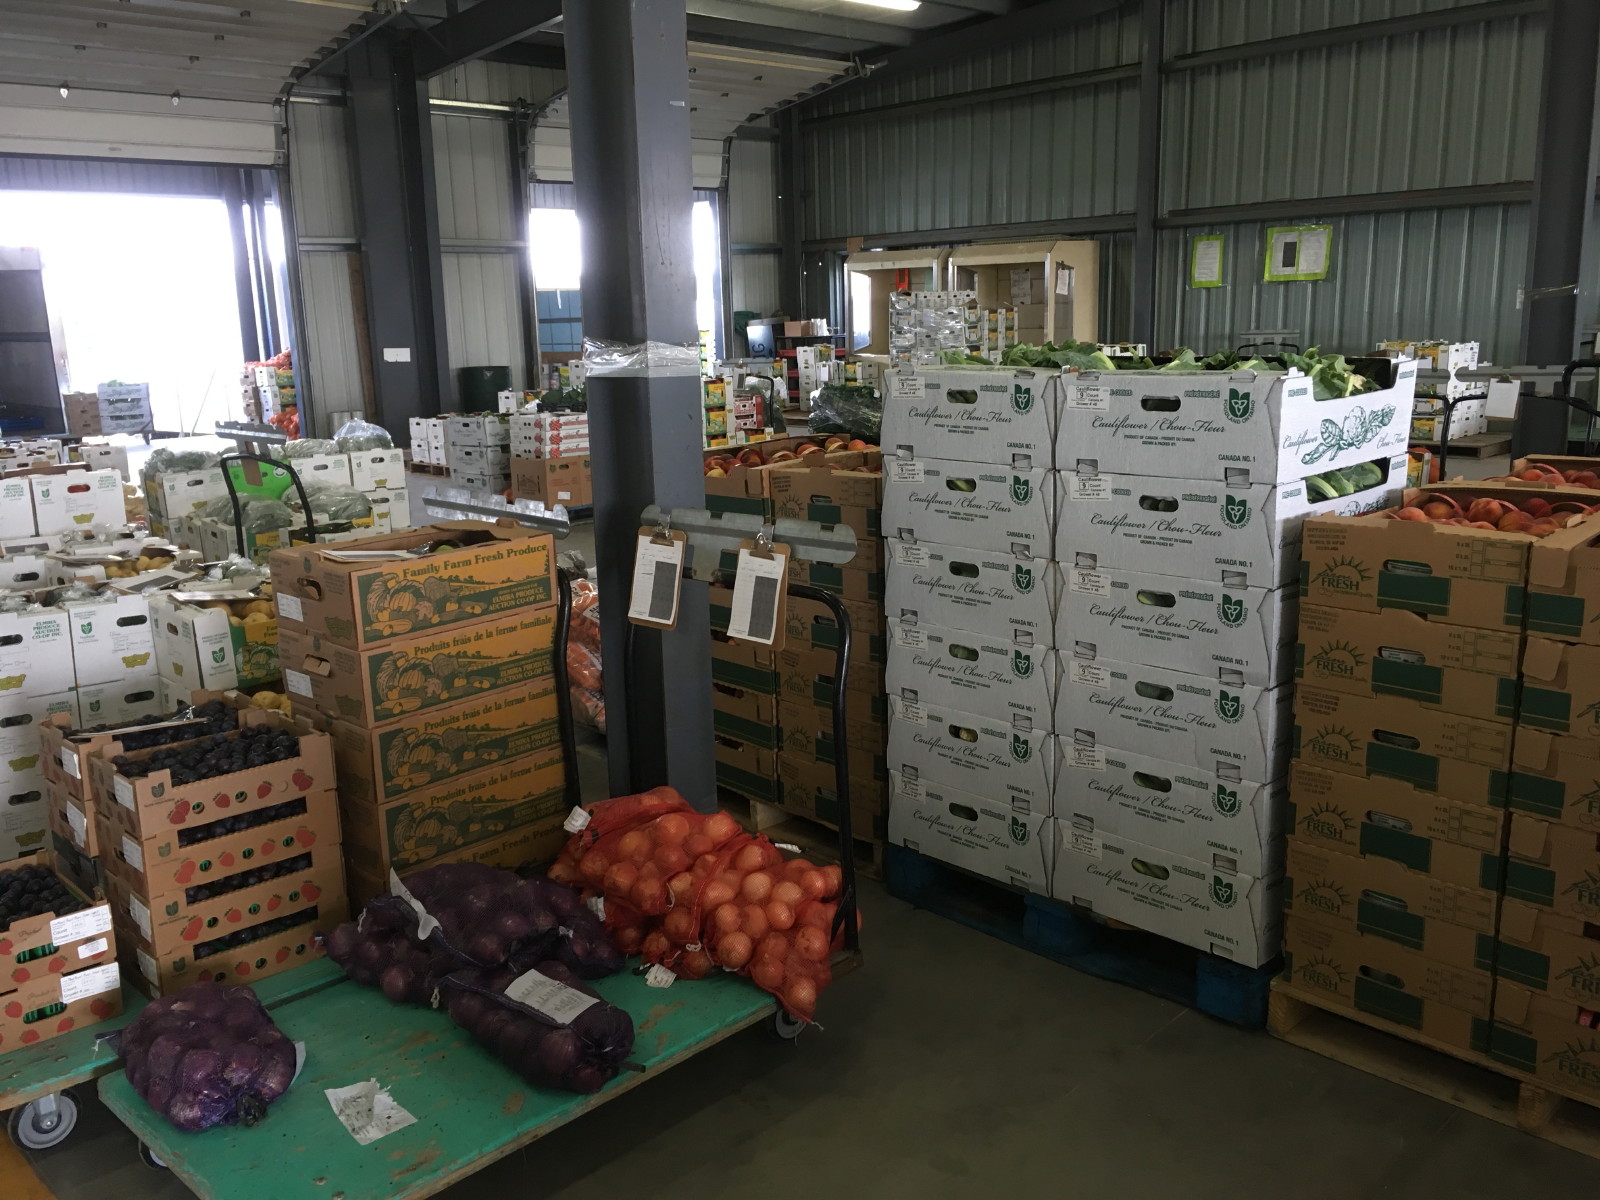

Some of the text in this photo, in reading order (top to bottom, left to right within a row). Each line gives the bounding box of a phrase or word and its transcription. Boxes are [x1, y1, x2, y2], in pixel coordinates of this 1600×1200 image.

[908, 405, 953, 426] Cauliflower
[1092, 414, 1148, 438] Cauliflower
[1282, 429, 1318, 455] Cauliflower
[909, 491, 953, 511] Cauliflower
[1090, 512, 1146, 535] Cauliflower
[403, 544, 546, 578] Family Farm Fresh Produce
[1215, 557, 1238, 566] CANADA
[913, 574, 956, 594] Cauliflower
[1322, 577, 1359, 591] FRESH
[492, 594, 515, 603] ELMIRA
[516, 587, 543, 598] PRODUCE
[1090, 603, 1144, 626] Cauliflower
[414, 616, 552, 655] Produits frais de la ferme familiale
[912, 654, 955, 674] Cauliflower
[1212, 654, 1234, 663] CANADA
[1317, 660, 1354, 675] FRESH
[424, 686, 556, 731] Produits frais de la ferme familial
[1089, 692, 1143, 714] Cauliflower
[1210, 747, 1232, 758] CANADA
[1312, 743, 1349, 760] FRESH
[431, 756, 561, 805] Produits frais de la ferme familial
[1088, 778, 1141, 802] Cauliflower
[1307, 821, 1343, 839] FRESH
[472, 847, 499, 861] Farm
[502, 834, 529, 851] Fresh
[1304, 894, 1340, 913] FRESH
[1303, 972, 1338, 990] FRESH
